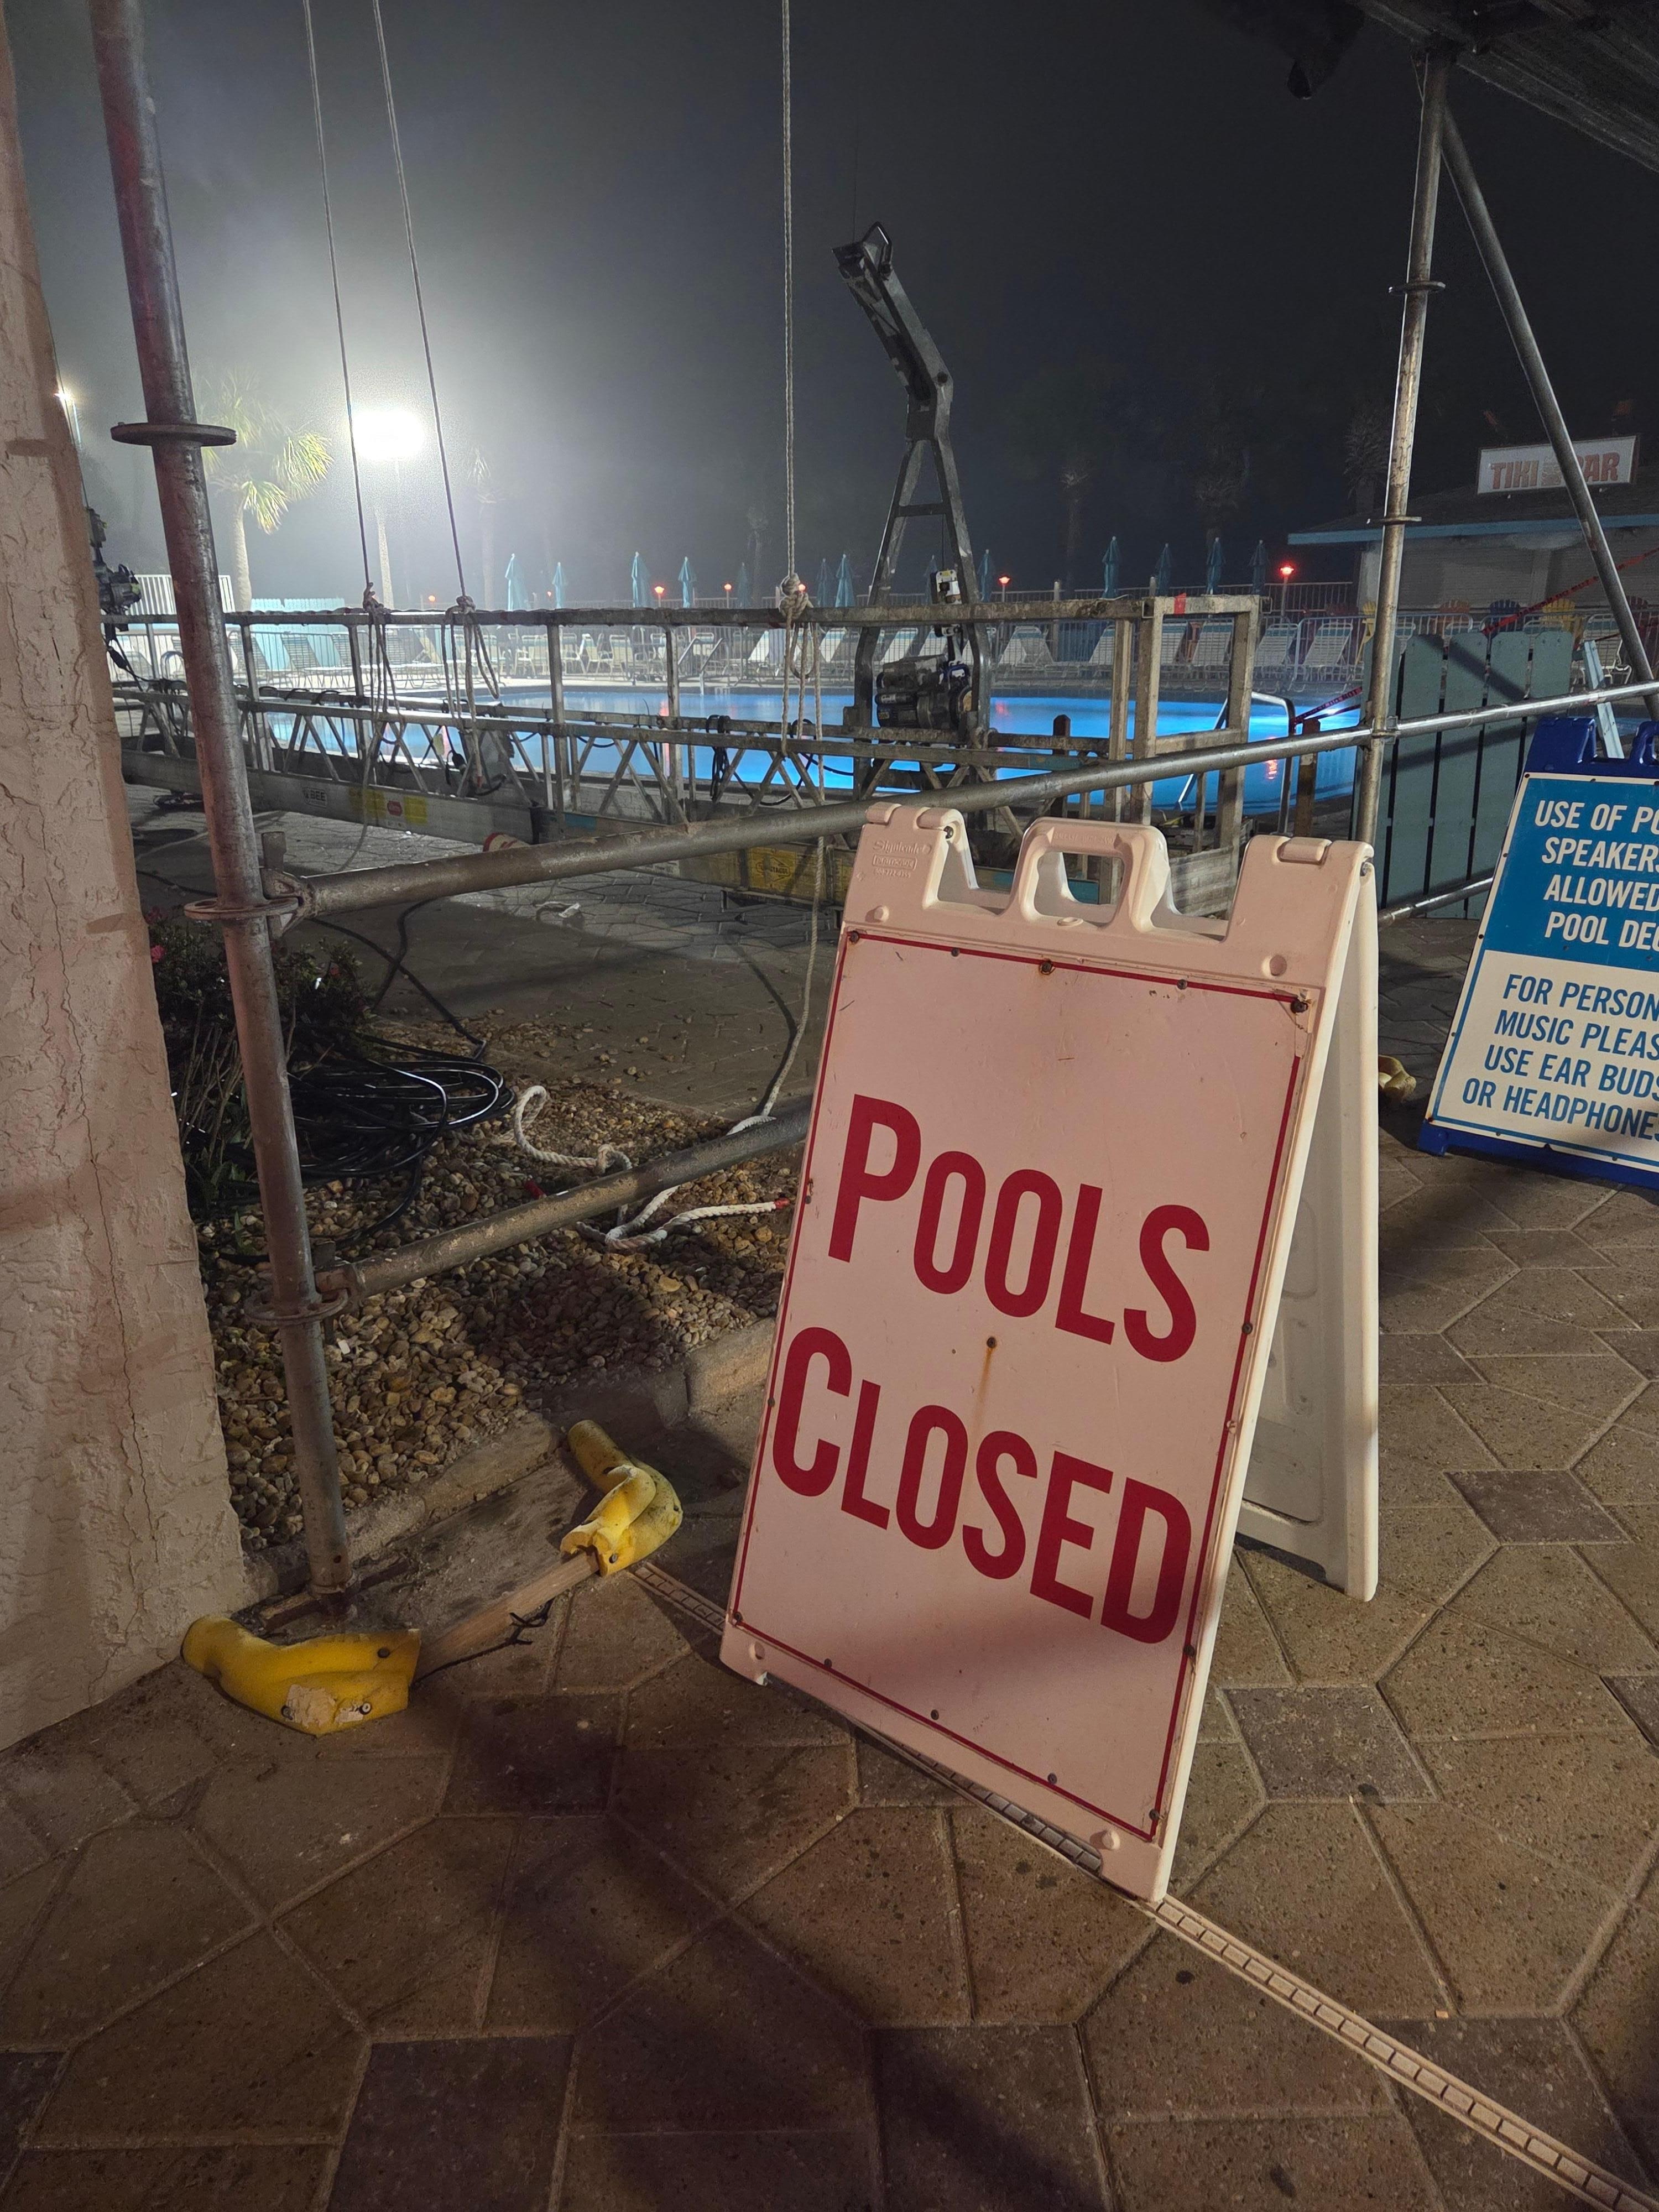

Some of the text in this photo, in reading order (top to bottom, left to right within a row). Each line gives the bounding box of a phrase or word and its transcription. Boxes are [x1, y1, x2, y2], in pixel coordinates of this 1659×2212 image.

[1490, 460, 1539, 489] TIKI
[1535, 800, 1585, 829] USE
[1590, 803, 1627, 831] OF
[1541, 836, 1659, 873] SPEAKER
[1543, 874, 1659, 911] ALLOWED
[1545, 911, 1609, 945] POOL
[1503, 974, 1659, 1021] FOR PERSON
[1494, 1009, 1659, 1061] MUSIC PLEAS
[1484, 1044, 1534, 1077] USE
[1538, 1053, 1592, 1088] EAR
[1462, 1078, 1659, 1142] OR HEADPHONE
[827, 1094, 1210, 1363] POOLS
[773, 1327, 1192, 1644] CLOSED
